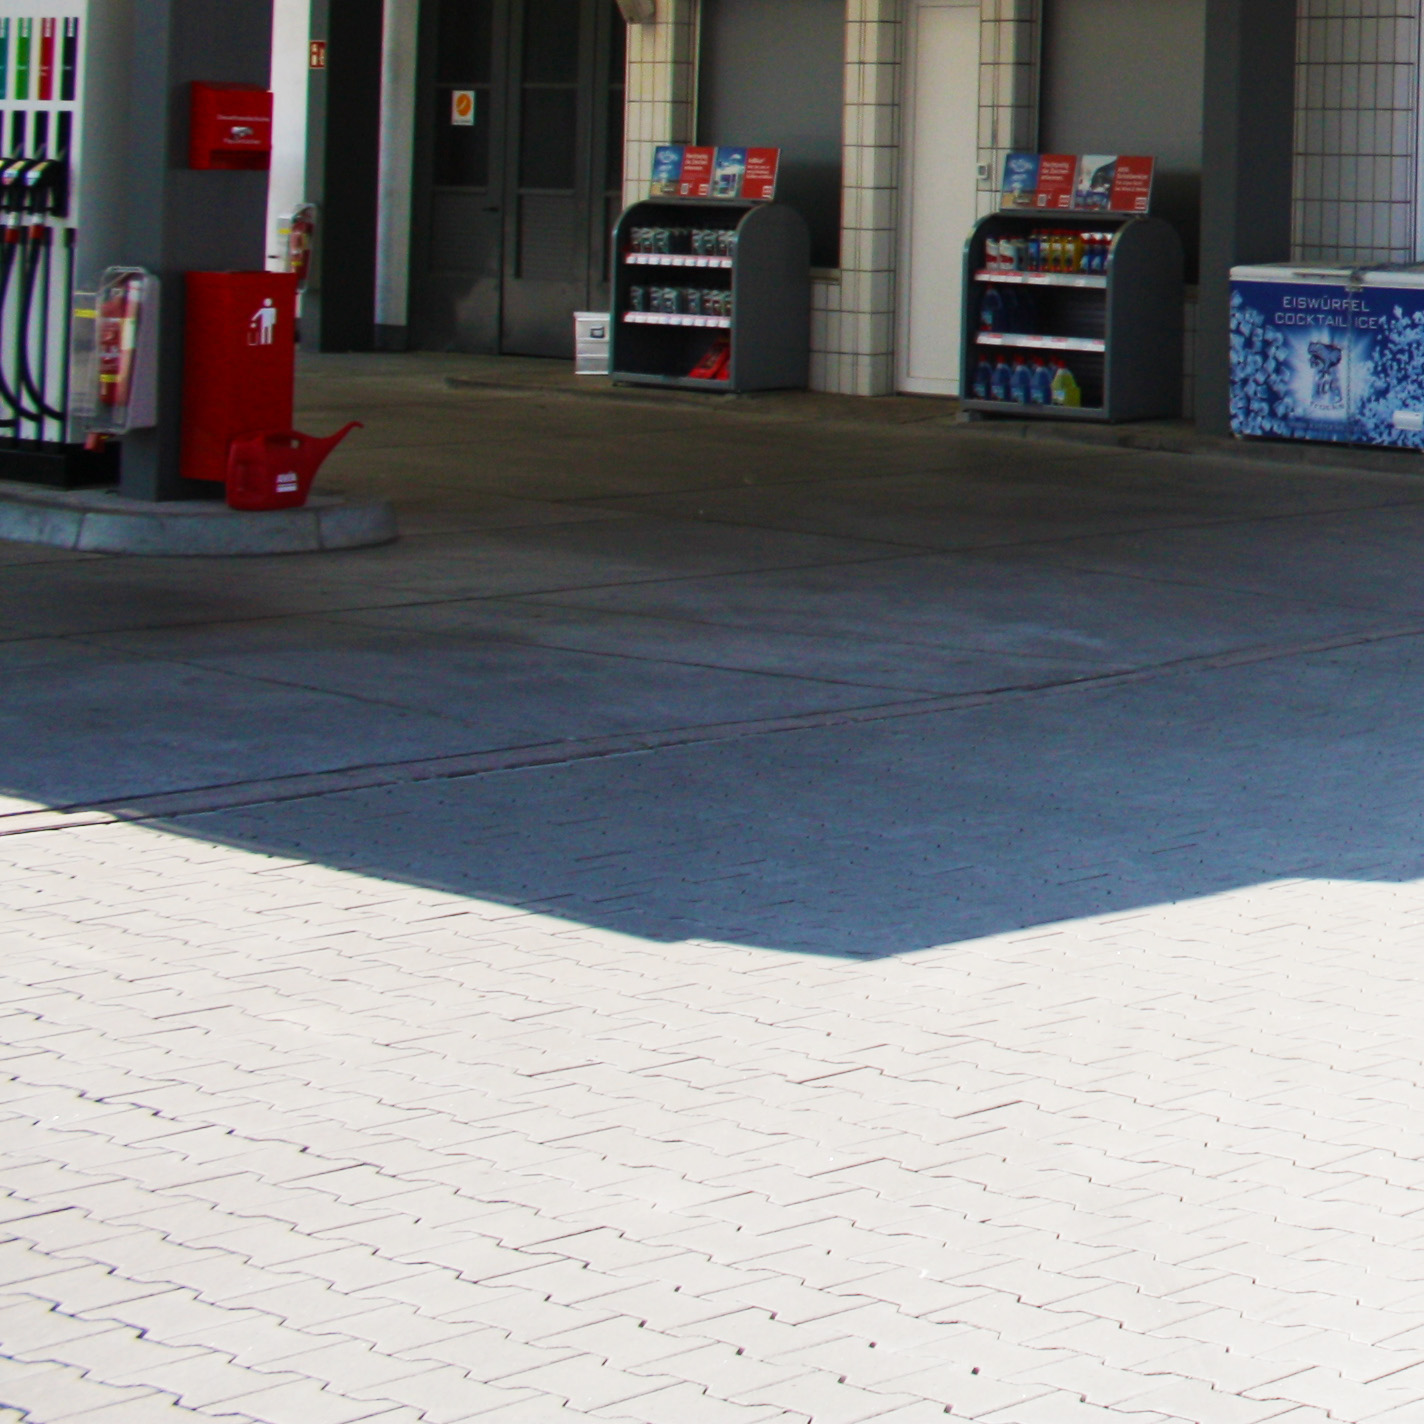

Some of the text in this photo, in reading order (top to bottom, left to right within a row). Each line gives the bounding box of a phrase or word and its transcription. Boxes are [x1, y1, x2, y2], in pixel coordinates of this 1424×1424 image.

[1283, 295, 1370, 313] EISWÜRFEL
[1275, 312, 1379, 329] COCKTAIL ICE
